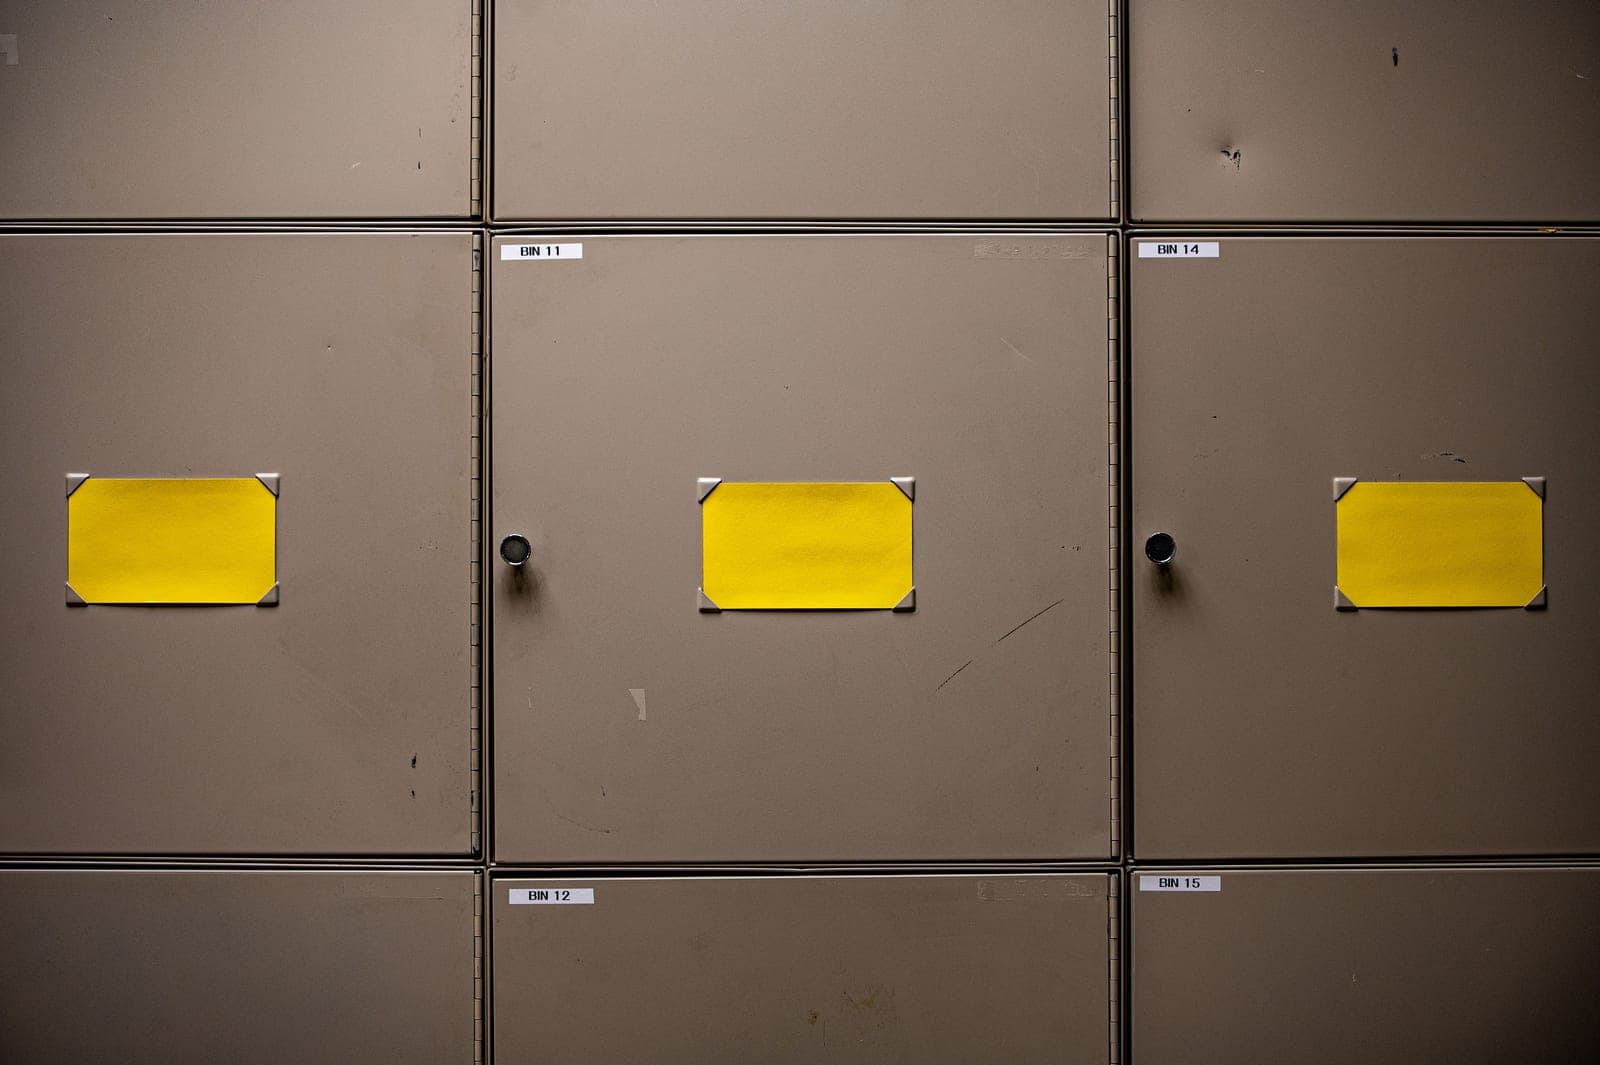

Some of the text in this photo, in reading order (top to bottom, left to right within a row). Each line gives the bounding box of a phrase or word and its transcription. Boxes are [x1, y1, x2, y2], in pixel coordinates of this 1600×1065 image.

[520, 245, 561, 257] BIN 11
[1157, 244, 1199, 255] BIN 14
[1158, 877, 1201, 888] BIN 15
[528, 890, 571, 901] BIN 12
